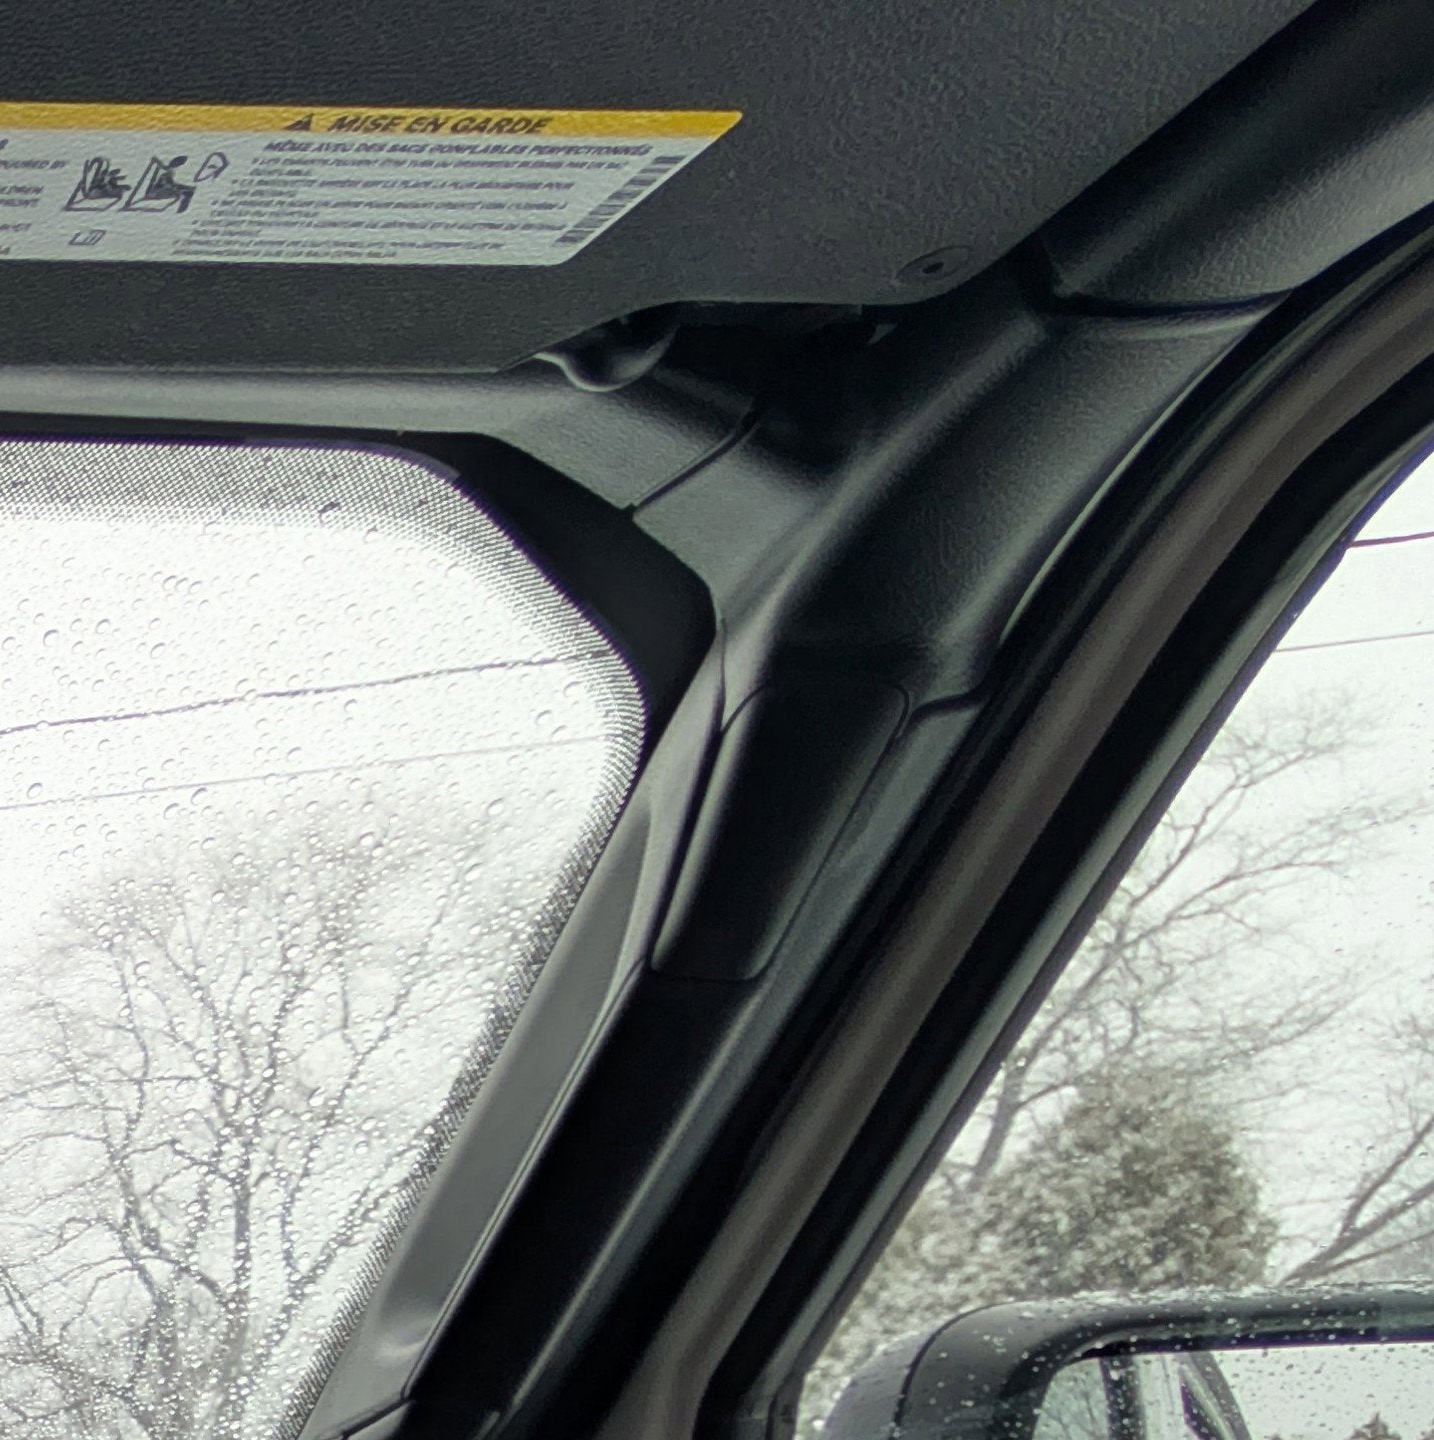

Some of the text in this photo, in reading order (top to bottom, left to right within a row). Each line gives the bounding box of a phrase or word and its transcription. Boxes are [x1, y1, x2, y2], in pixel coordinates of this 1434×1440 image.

[326, 115, 554, 134] MISE EN GARDE
